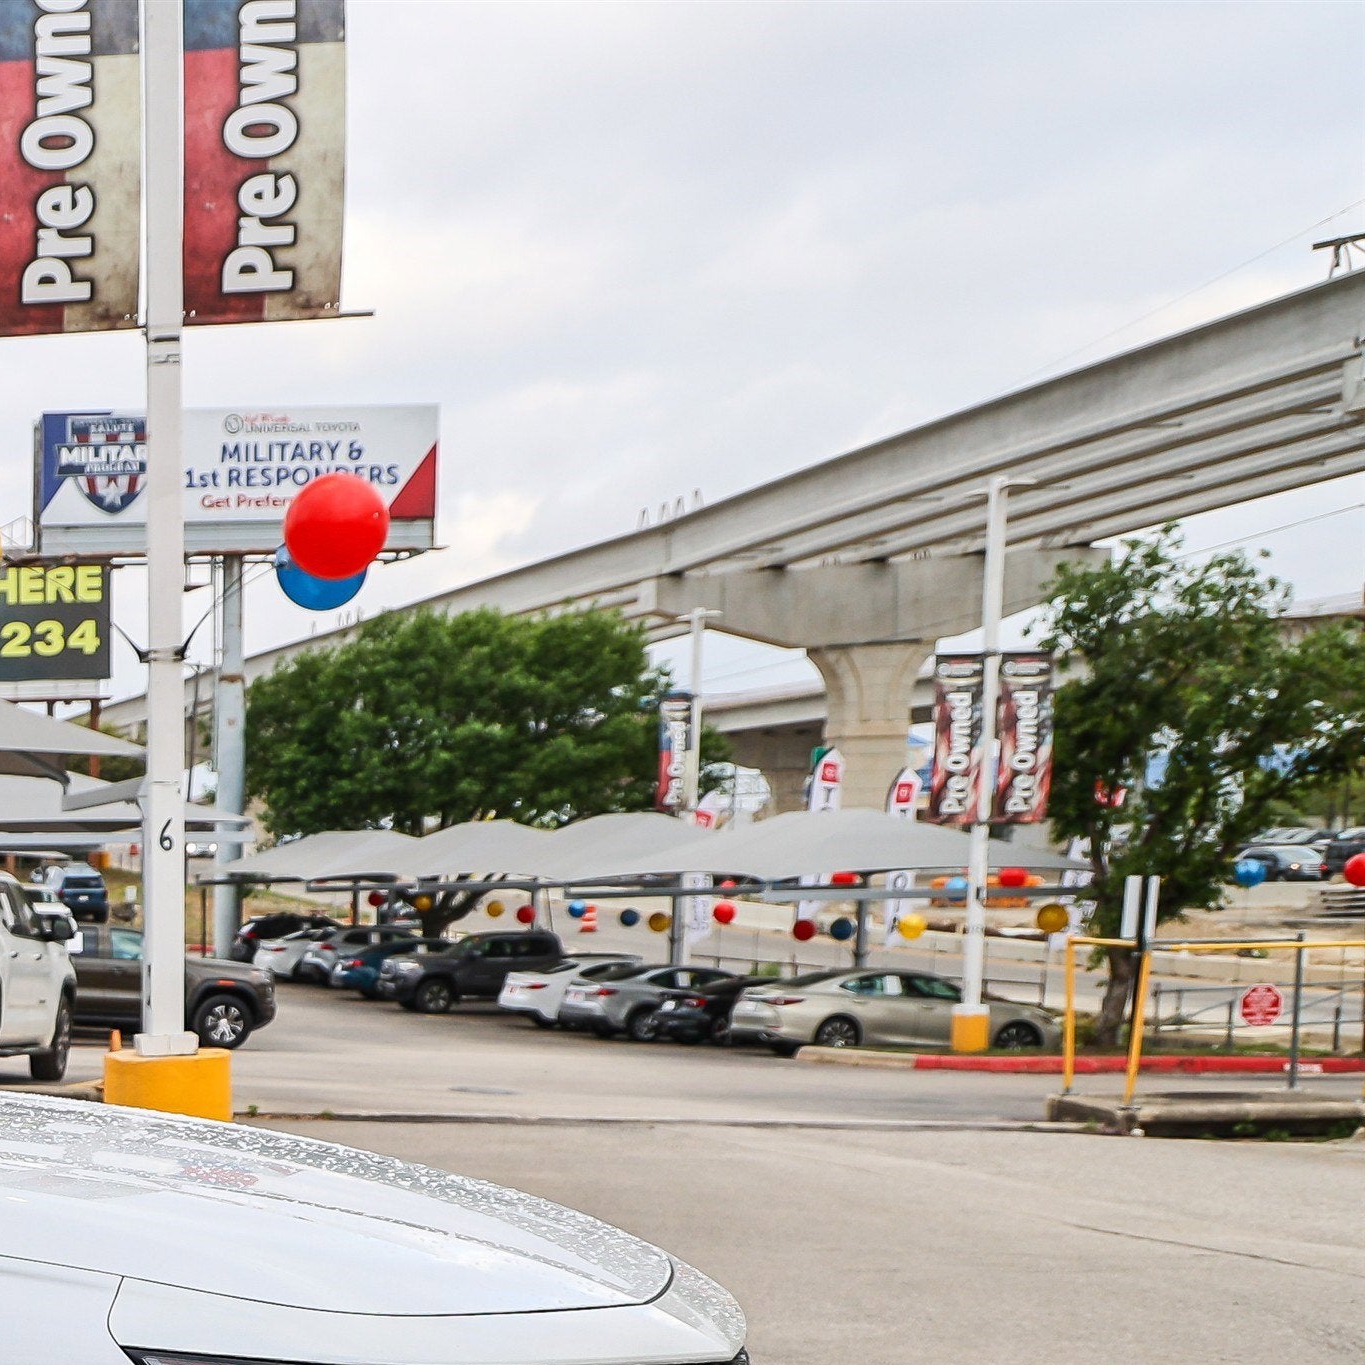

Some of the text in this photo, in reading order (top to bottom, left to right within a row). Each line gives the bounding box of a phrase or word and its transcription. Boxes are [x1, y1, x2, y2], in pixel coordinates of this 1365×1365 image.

[21, 0, 95, 304] Pre Own
[222, 172, 297, 294] Pre
[220, 439, 364, 463] MILITARY &
[185, 466, 219, 488] 1st
[201, 494, 230, 509] Get
[943, 690, 973, 772] Owned
[1010, 689, 1040, 771] Owned
[938, 774, 969, 815] Pre
[1004, 773, 1036, 814] Pre
[159, 816, 174, 852] 6
